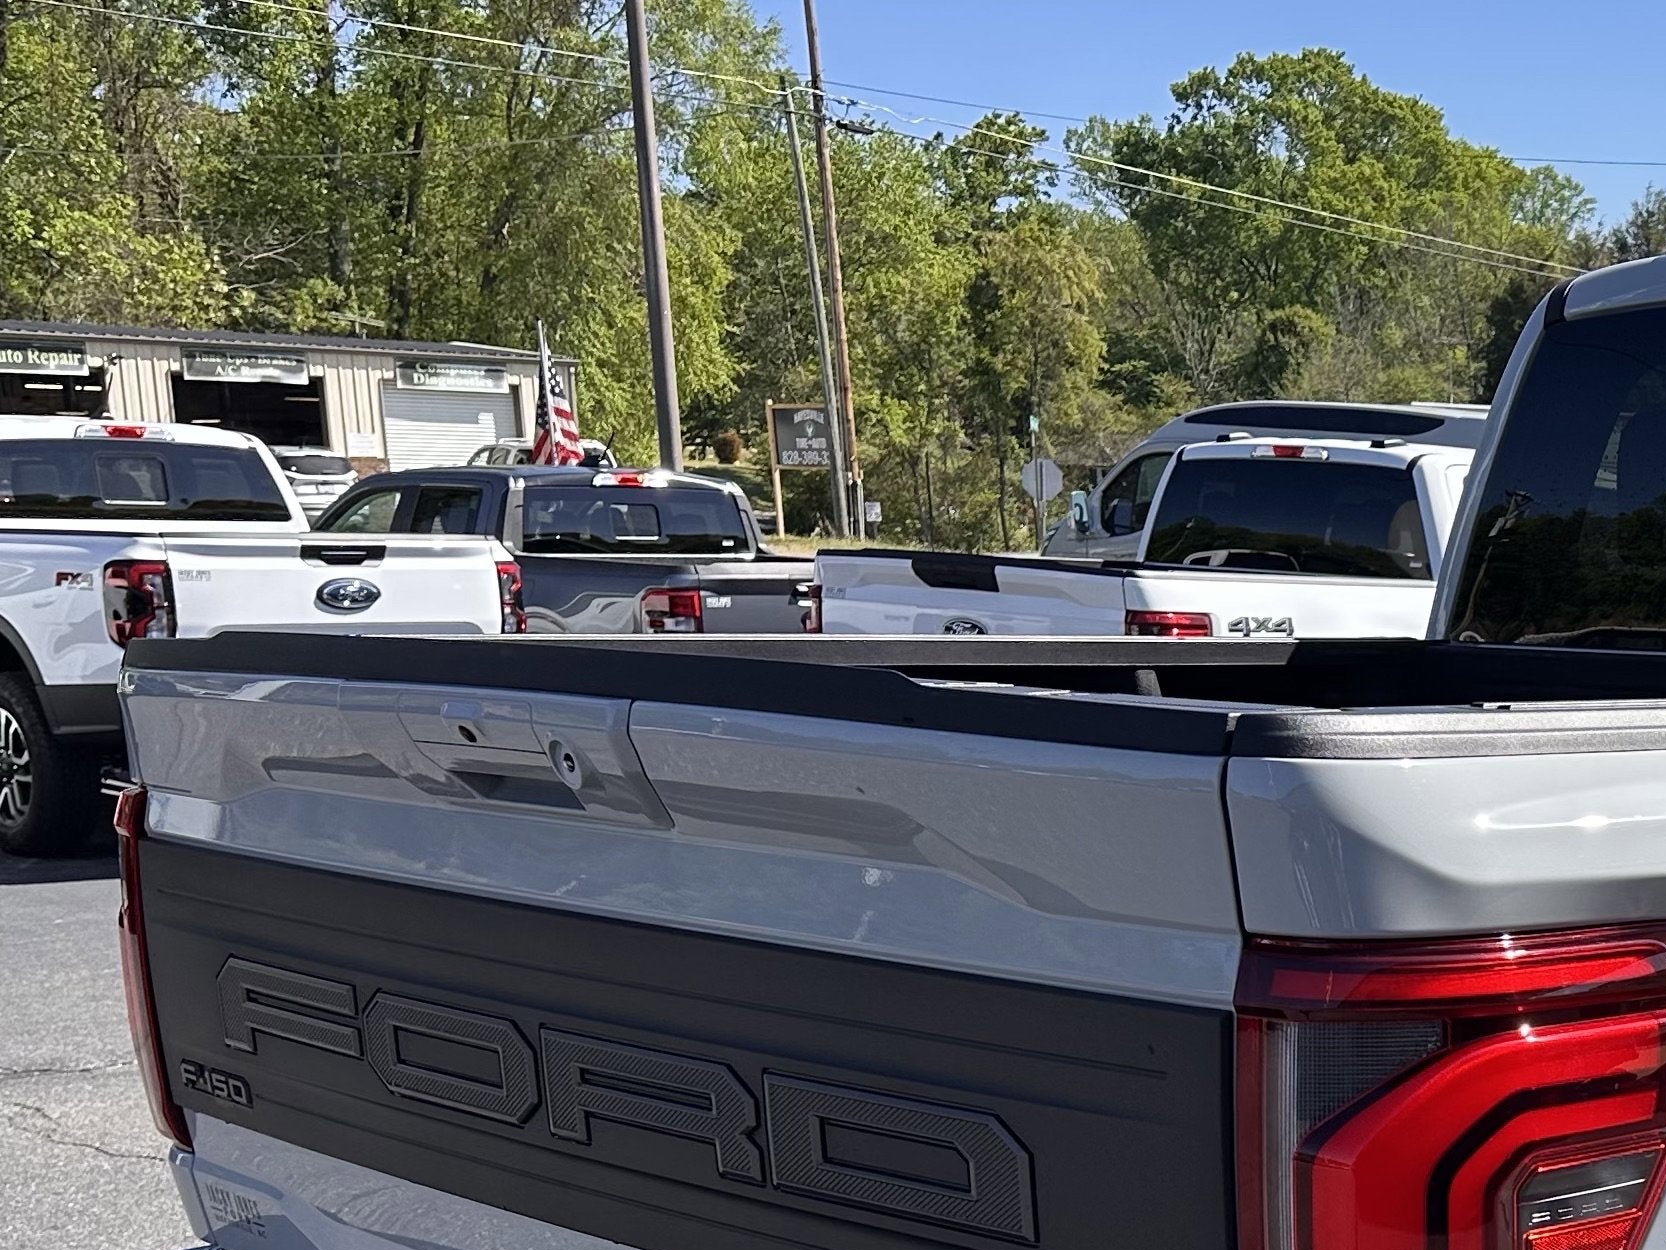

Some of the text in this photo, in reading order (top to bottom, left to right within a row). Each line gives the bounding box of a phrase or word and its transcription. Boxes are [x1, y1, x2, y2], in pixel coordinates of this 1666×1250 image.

[0, 348, 81, 369] uto Repair
[782, 450, 830, 465] 828-389-3
[217, 953, 1039, 1246] FORD
